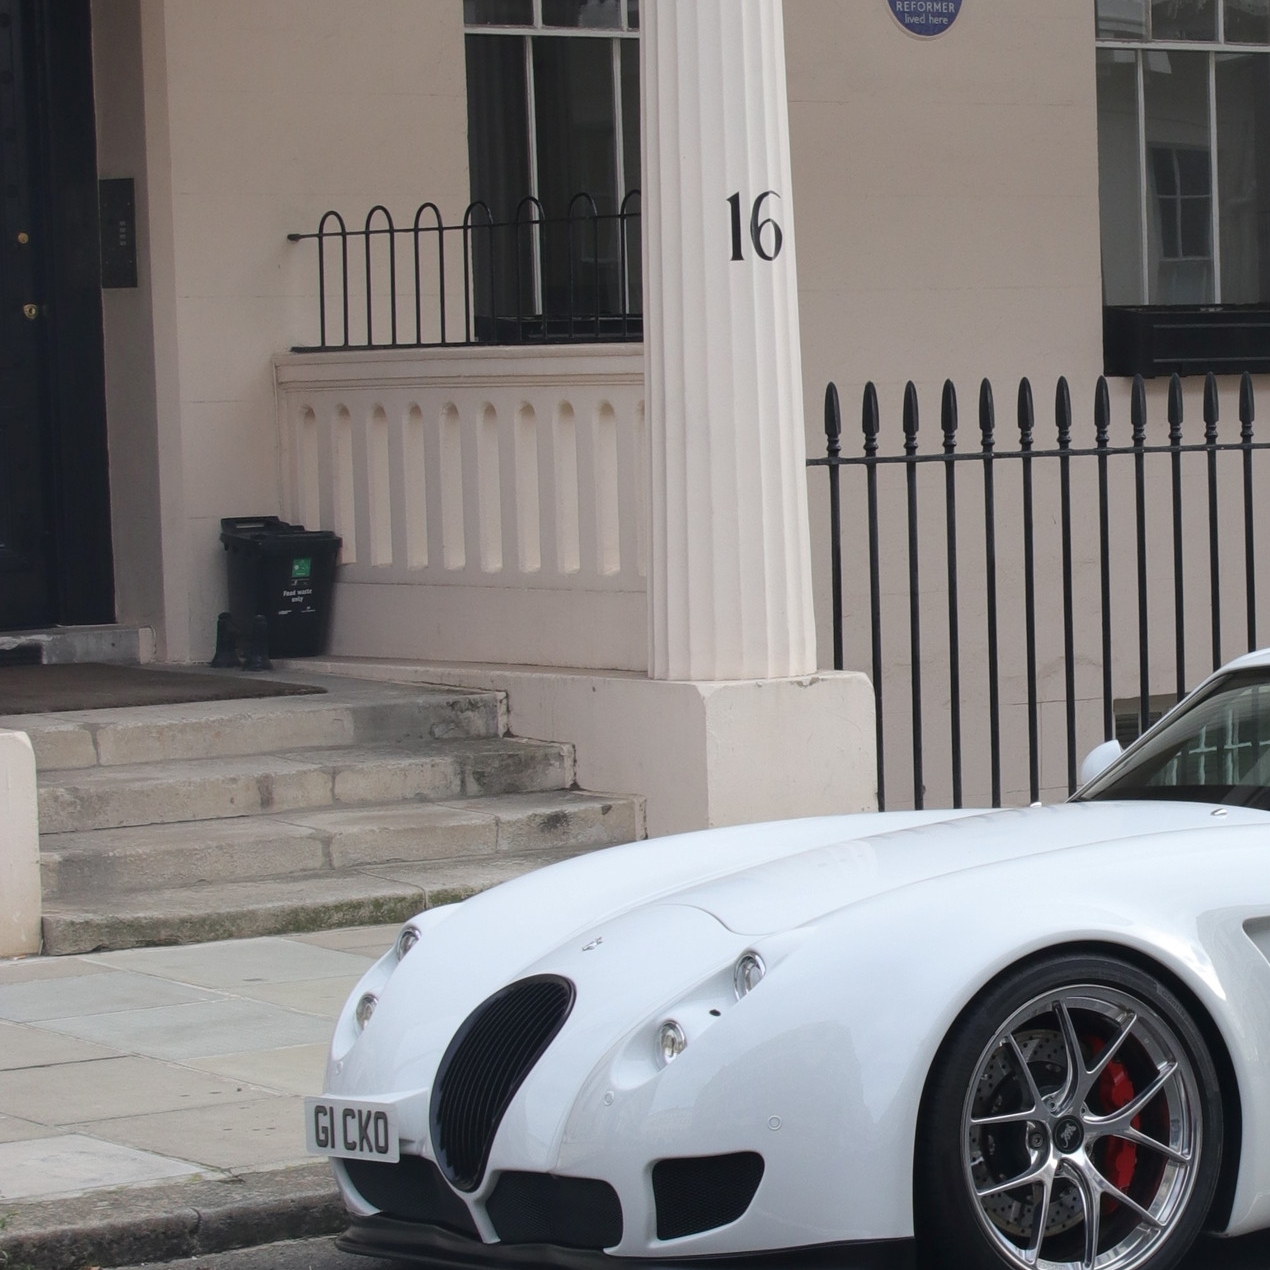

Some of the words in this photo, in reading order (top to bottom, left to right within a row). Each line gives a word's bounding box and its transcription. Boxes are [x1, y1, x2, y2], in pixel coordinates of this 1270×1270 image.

[896, 1, 955, 13] REFORMER
[904, 14, 925, 24] lived
[929, 14, 948, 25] here
[726, 190, 783, 261] 16
[297, 588, 312, 596] waste
